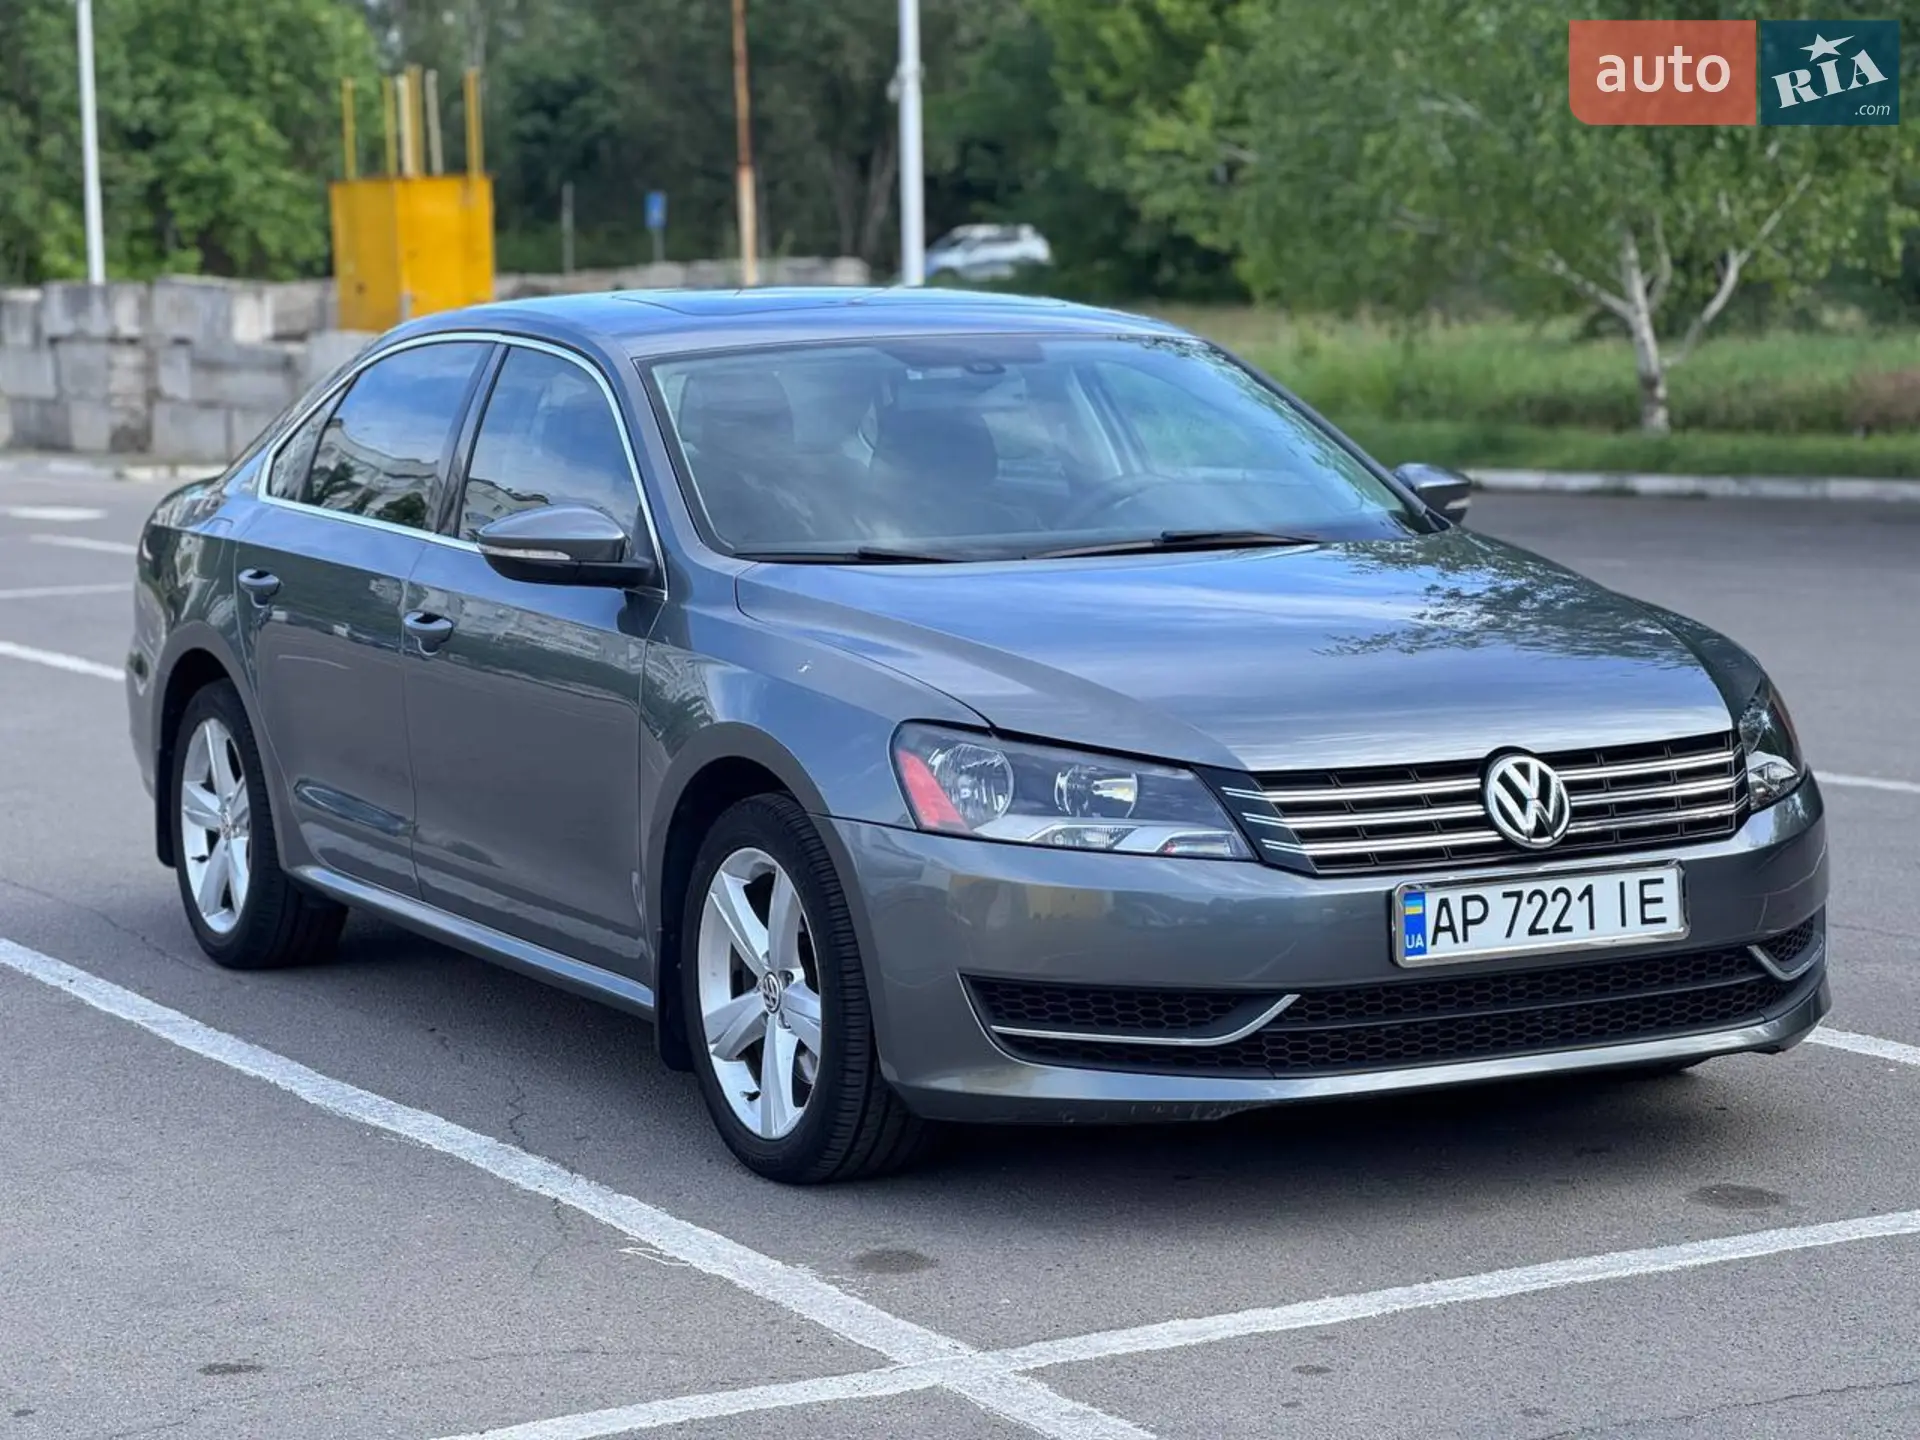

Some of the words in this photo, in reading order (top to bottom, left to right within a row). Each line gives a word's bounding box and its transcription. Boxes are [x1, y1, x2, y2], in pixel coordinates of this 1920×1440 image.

[1430, 894, 1489, 946] AP
[1501, 883, 1596, 939] 7221
[1618, 877, 1668, 928] IE
[1405, 933, 1425, 950] UA
